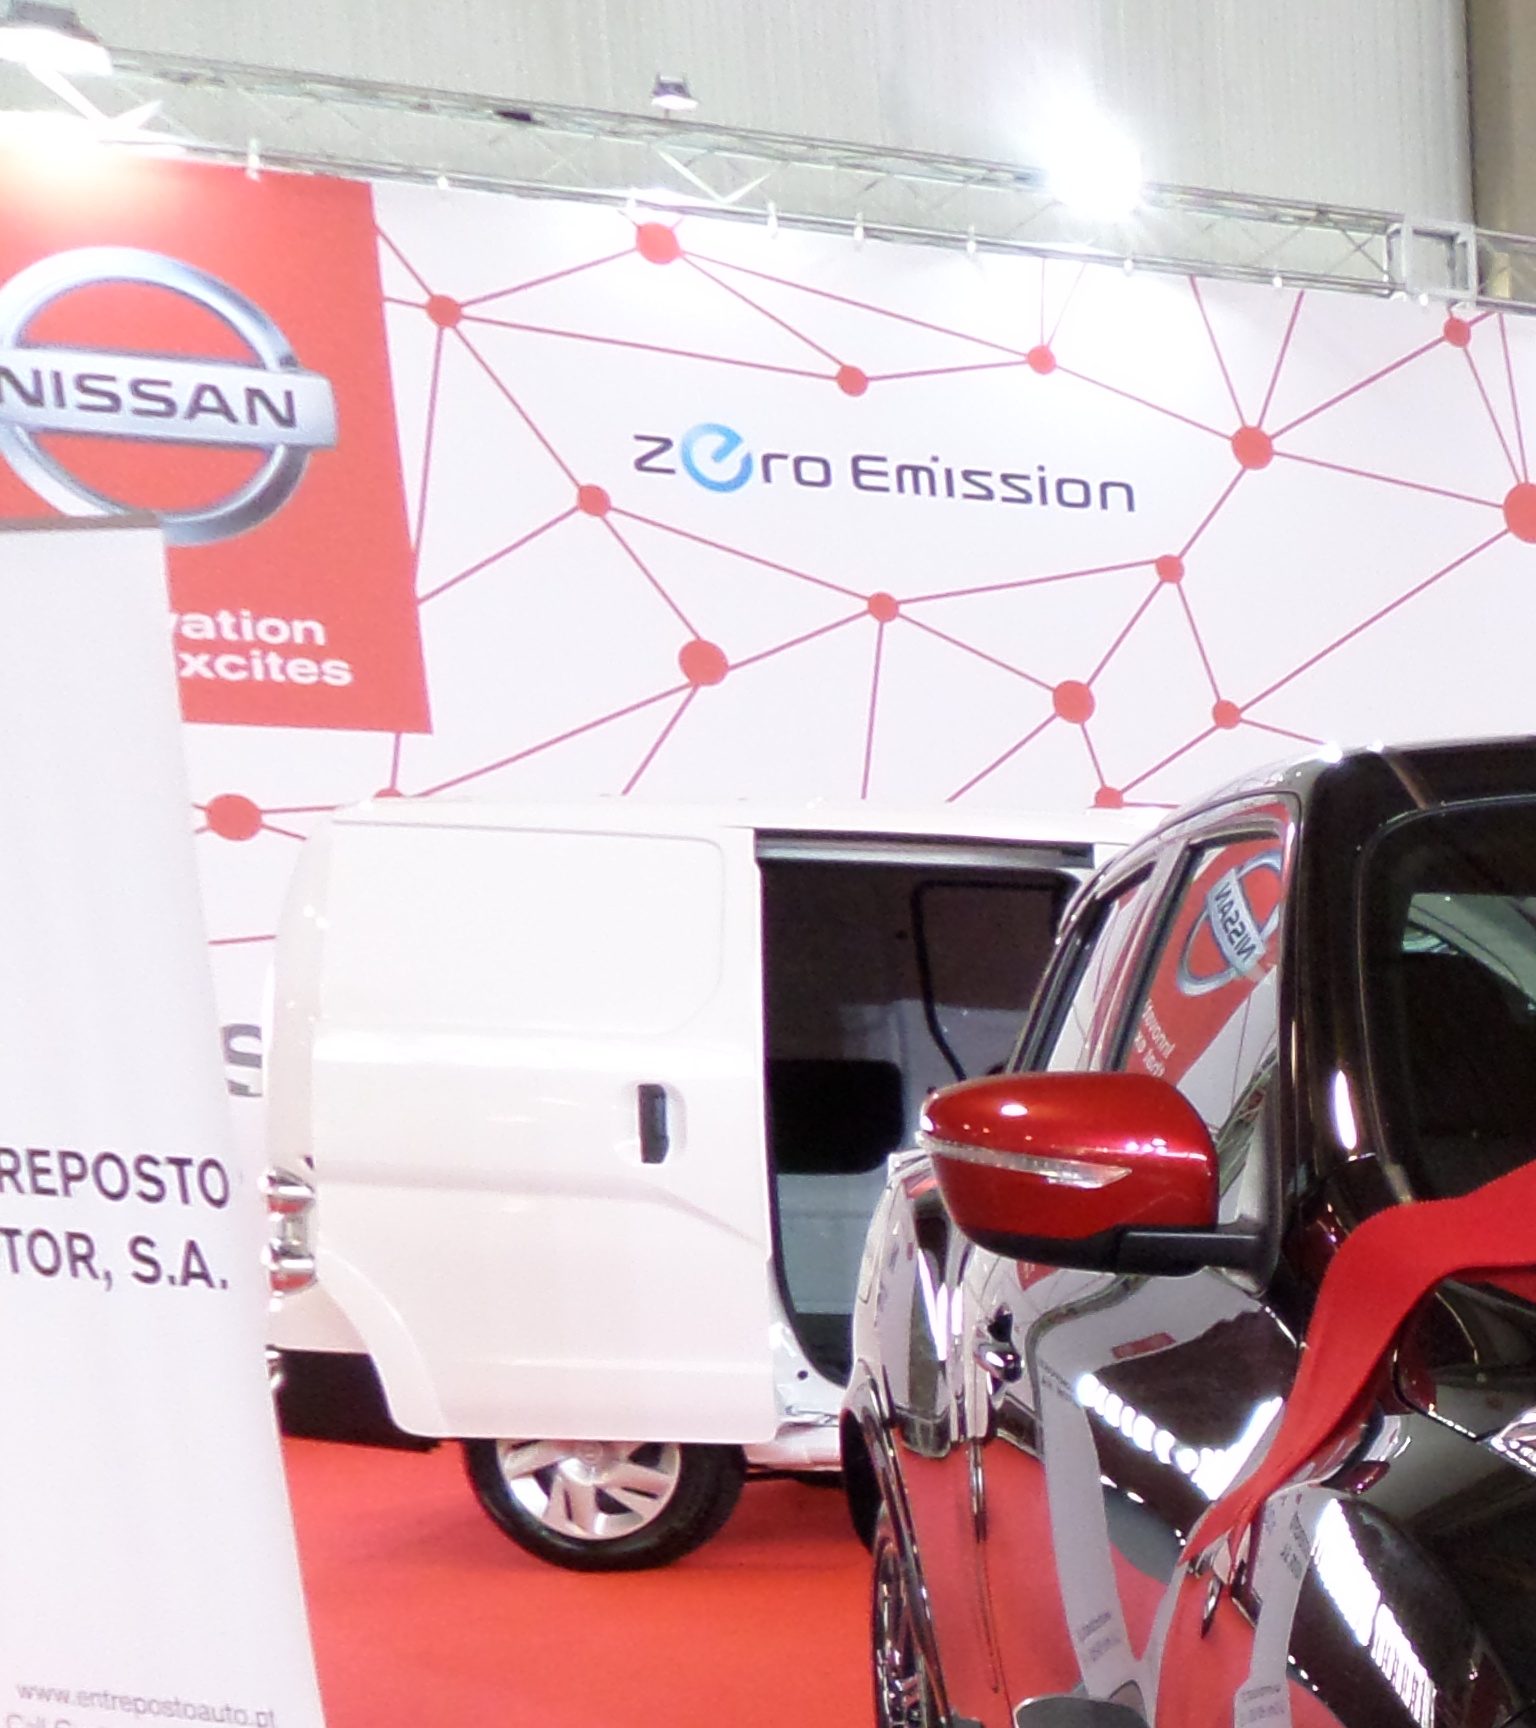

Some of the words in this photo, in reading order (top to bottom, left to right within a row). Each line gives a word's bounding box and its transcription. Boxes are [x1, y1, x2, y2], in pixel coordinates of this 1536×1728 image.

[0, 365, 297, 428] NISSAN
[851, 454, 1136, 513] Emission
[178, 650, 354, 687] xcites
[0, 1147, 230, 1209] REPOSTO
[0, 1227, 113, 1292] TOR,
[128, 1235, 228, 1290] S.A.
